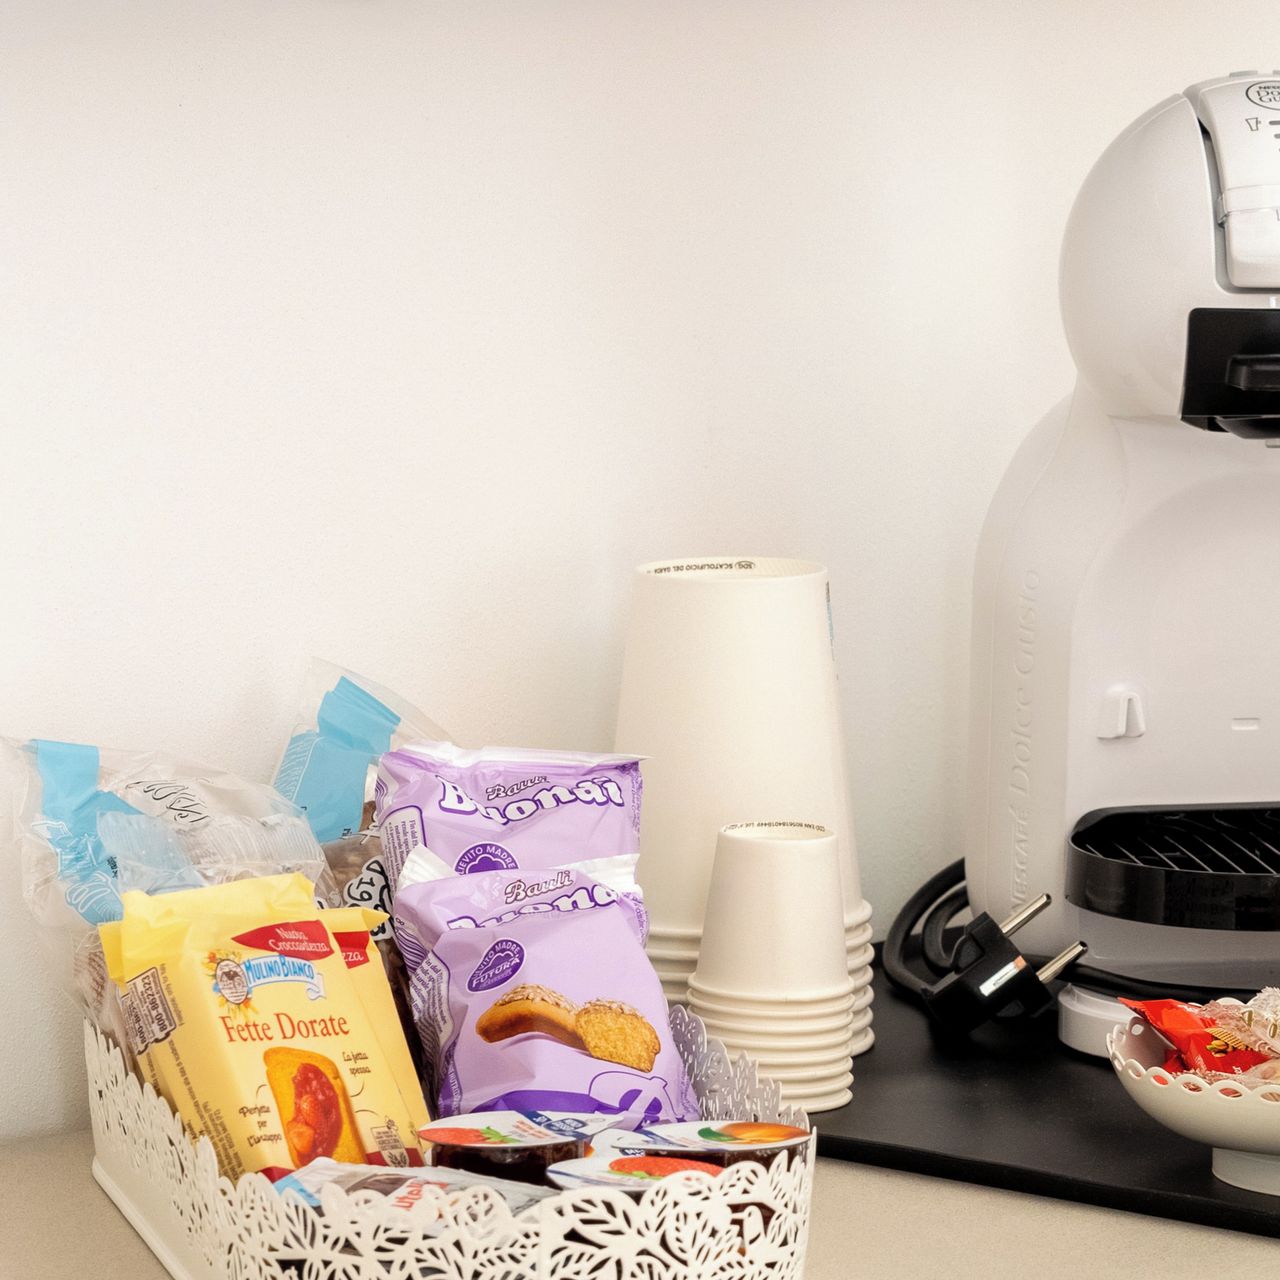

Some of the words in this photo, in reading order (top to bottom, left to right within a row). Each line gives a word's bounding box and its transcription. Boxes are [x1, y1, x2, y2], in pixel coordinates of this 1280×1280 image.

[486, 845, 516, 869] MADRE
[505, 870, 574, 904] Bauli
[244, 957, 281, 985] MULINO
[279, 954, 315, 981] BIANCO
[219, 1016, 273, 1043] Fette
[274, 1012, 350, 1040] Dorate
